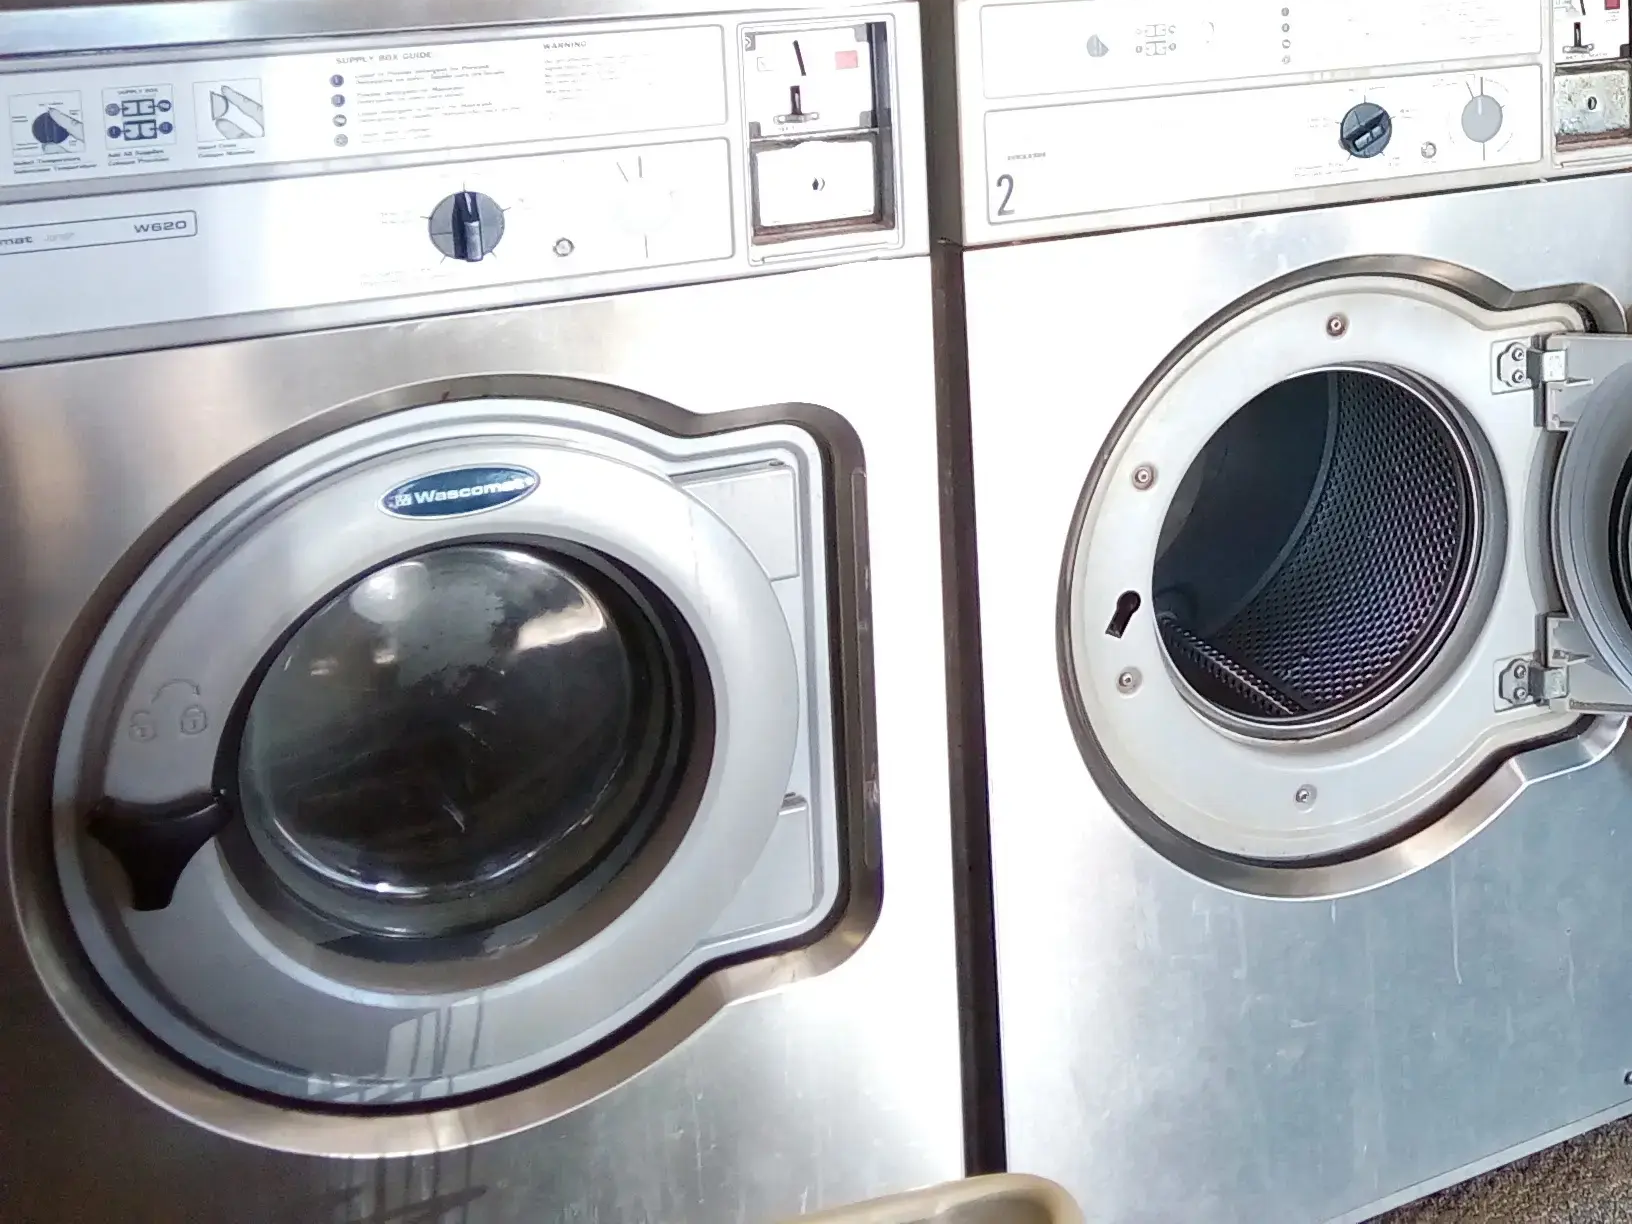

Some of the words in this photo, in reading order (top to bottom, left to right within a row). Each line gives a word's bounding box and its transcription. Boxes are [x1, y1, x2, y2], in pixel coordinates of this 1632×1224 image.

[996, 173, 1016, 217] 2
[133, 219, 187, 234] W620
[413, 476, 527, 505] Wascomat
